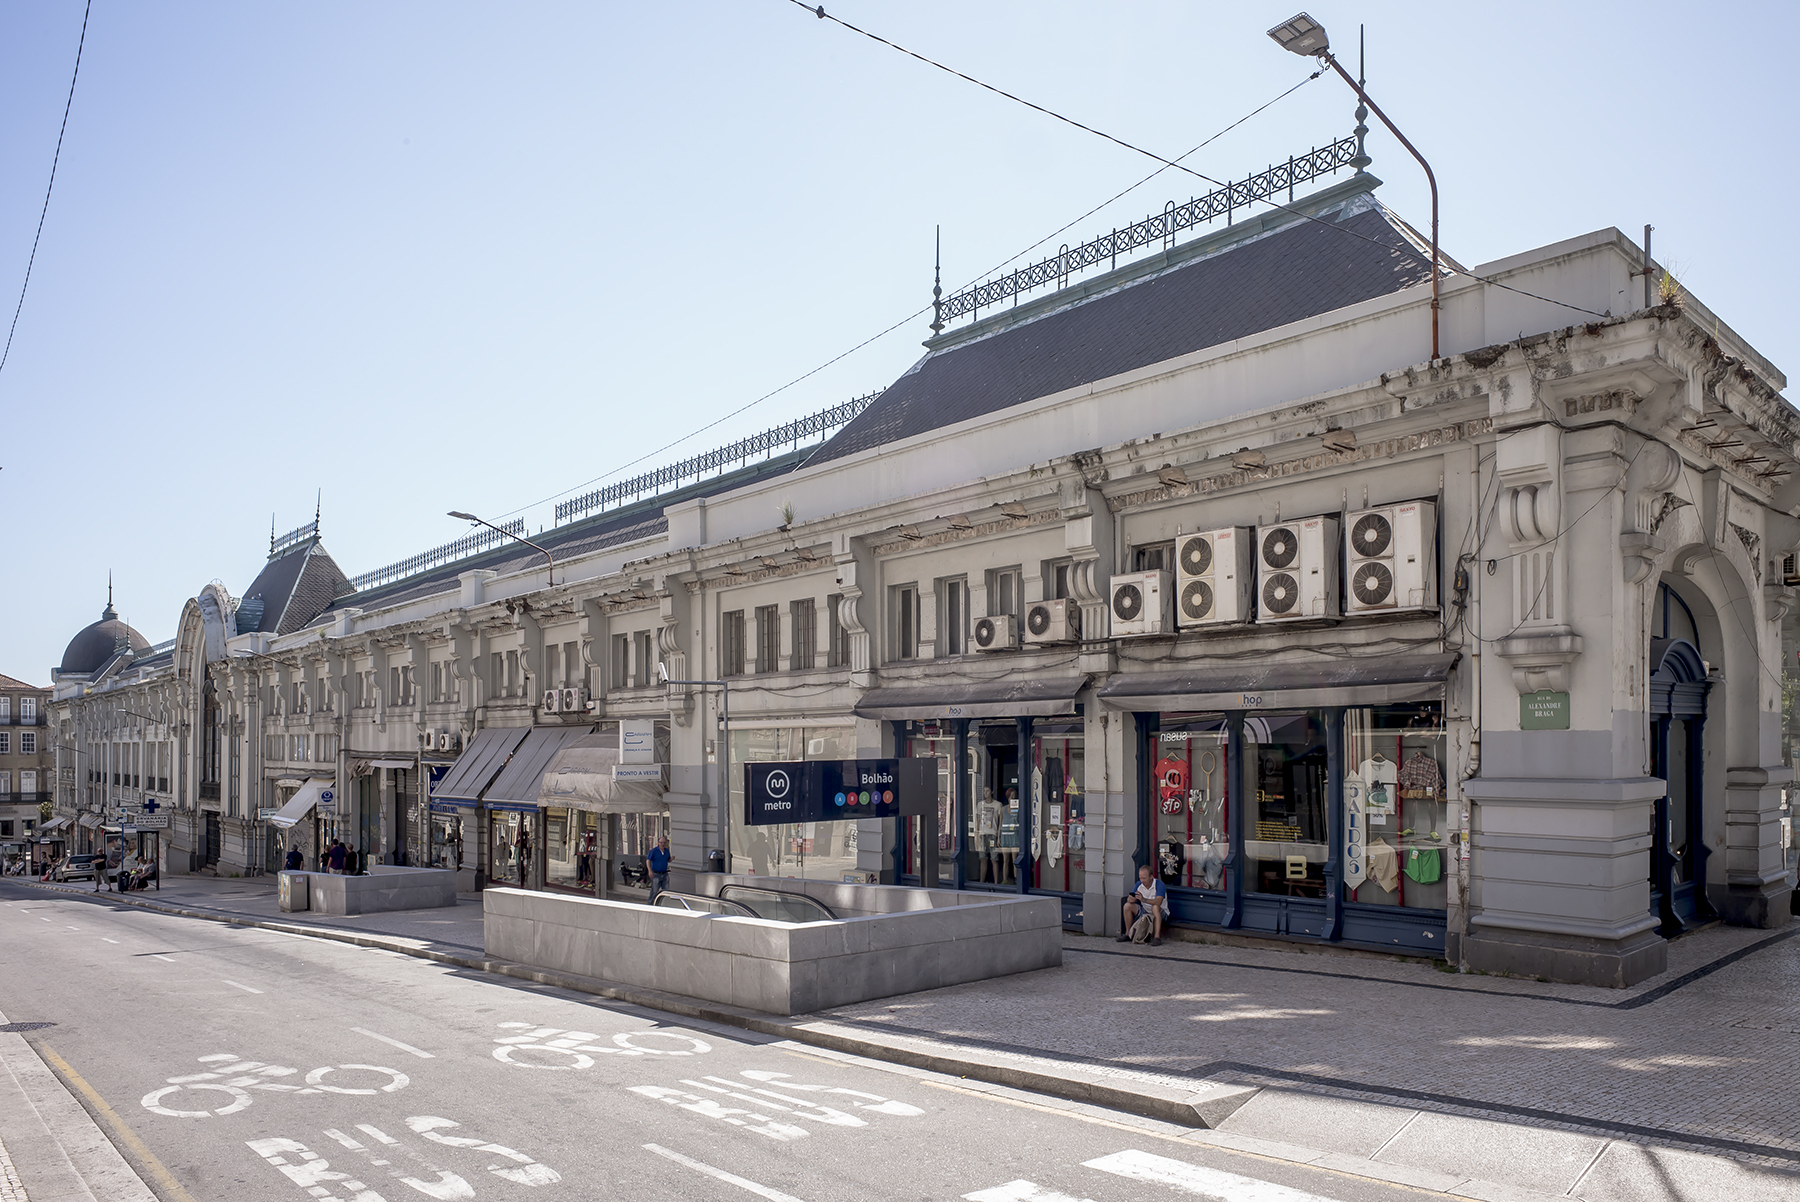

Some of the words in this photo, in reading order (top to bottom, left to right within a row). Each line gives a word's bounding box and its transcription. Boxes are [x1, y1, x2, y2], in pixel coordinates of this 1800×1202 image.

[764, 800, 792, 810] metro
[861, 772, 893, 784] Bolhão
[1347, 783, 1362, 875] SALDOS
[626, 1070, 926, 1141] BUS
[245, 1115, 563, 1202] BUS
